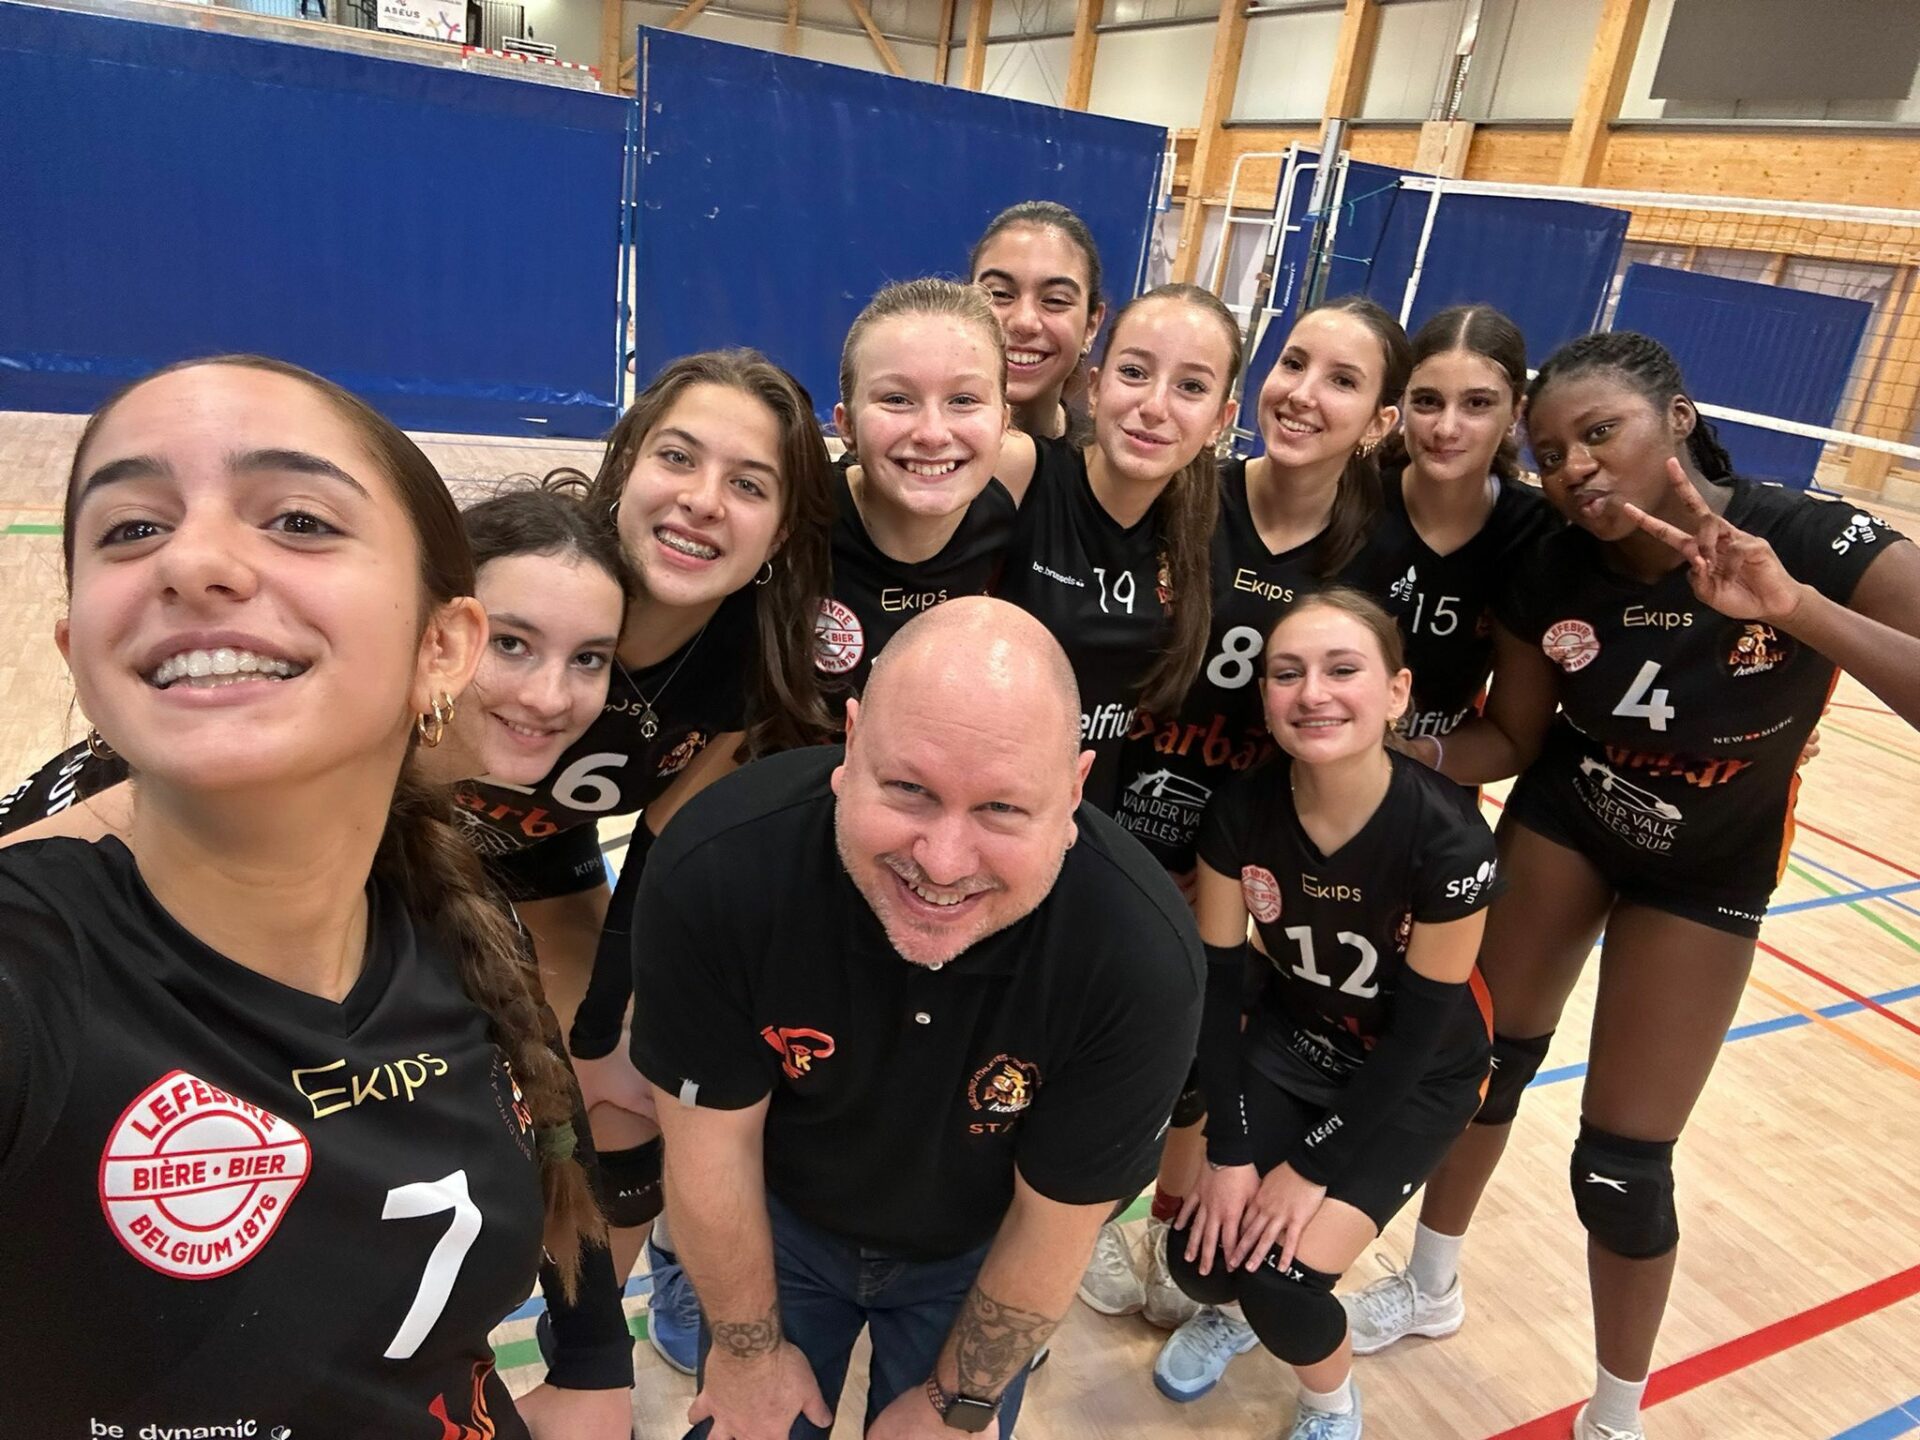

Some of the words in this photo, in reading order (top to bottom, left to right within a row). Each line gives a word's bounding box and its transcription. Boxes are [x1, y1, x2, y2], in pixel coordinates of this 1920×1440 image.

[384, 6, 421, 19] ASEUS
[1858, 526, 1877, 543] ULB
[881, 587, 947, 612] Ekips
[1093, 567, 1136, 614] 19
[1233, 568, 1294, 603] Ekips
[1412, 593, 1460, 636] 15
[1623, 605, 1693, 631] Ekips
[831, 633, 855, 643] BIER
[838, 652, 856, 668] 1876
[1207, 626, 1264, 689] 8
[1612, 660, 1675, 732] 4
[1713, 735, 1744, 744] NEW
[1123, 792, 1148, 815] VAN
[1149, 798, 1179, 822] DER
[1183, 808, 1200, 827] VA
[1632, 813, 1678, 840] VALK
[1114, 810, 1195, 844] NIVELLES-S
[574, 858, 602, 877] KIPS
[1302, 873, 1362, 902] Ekips
[1464, 883, 1482, 904] ULB
[1285, 925, 1380, 999] 12
[292, 1052, 449, 1119] Ekips
[1304, 1114, 1344, 1148] KIPSTA
[133, 1159, 207, 1191] BIÈRE
[228, 1154, 286, 1178] BIER
[128, 1214, 233, 1265] BELGIUM
[234, 1194, 278, 1249] 1876
[382, 1168, 484, 1360] 7
[90, 1418, 124, 1438] be
[138, 1418, 258, 1440] dynamic
